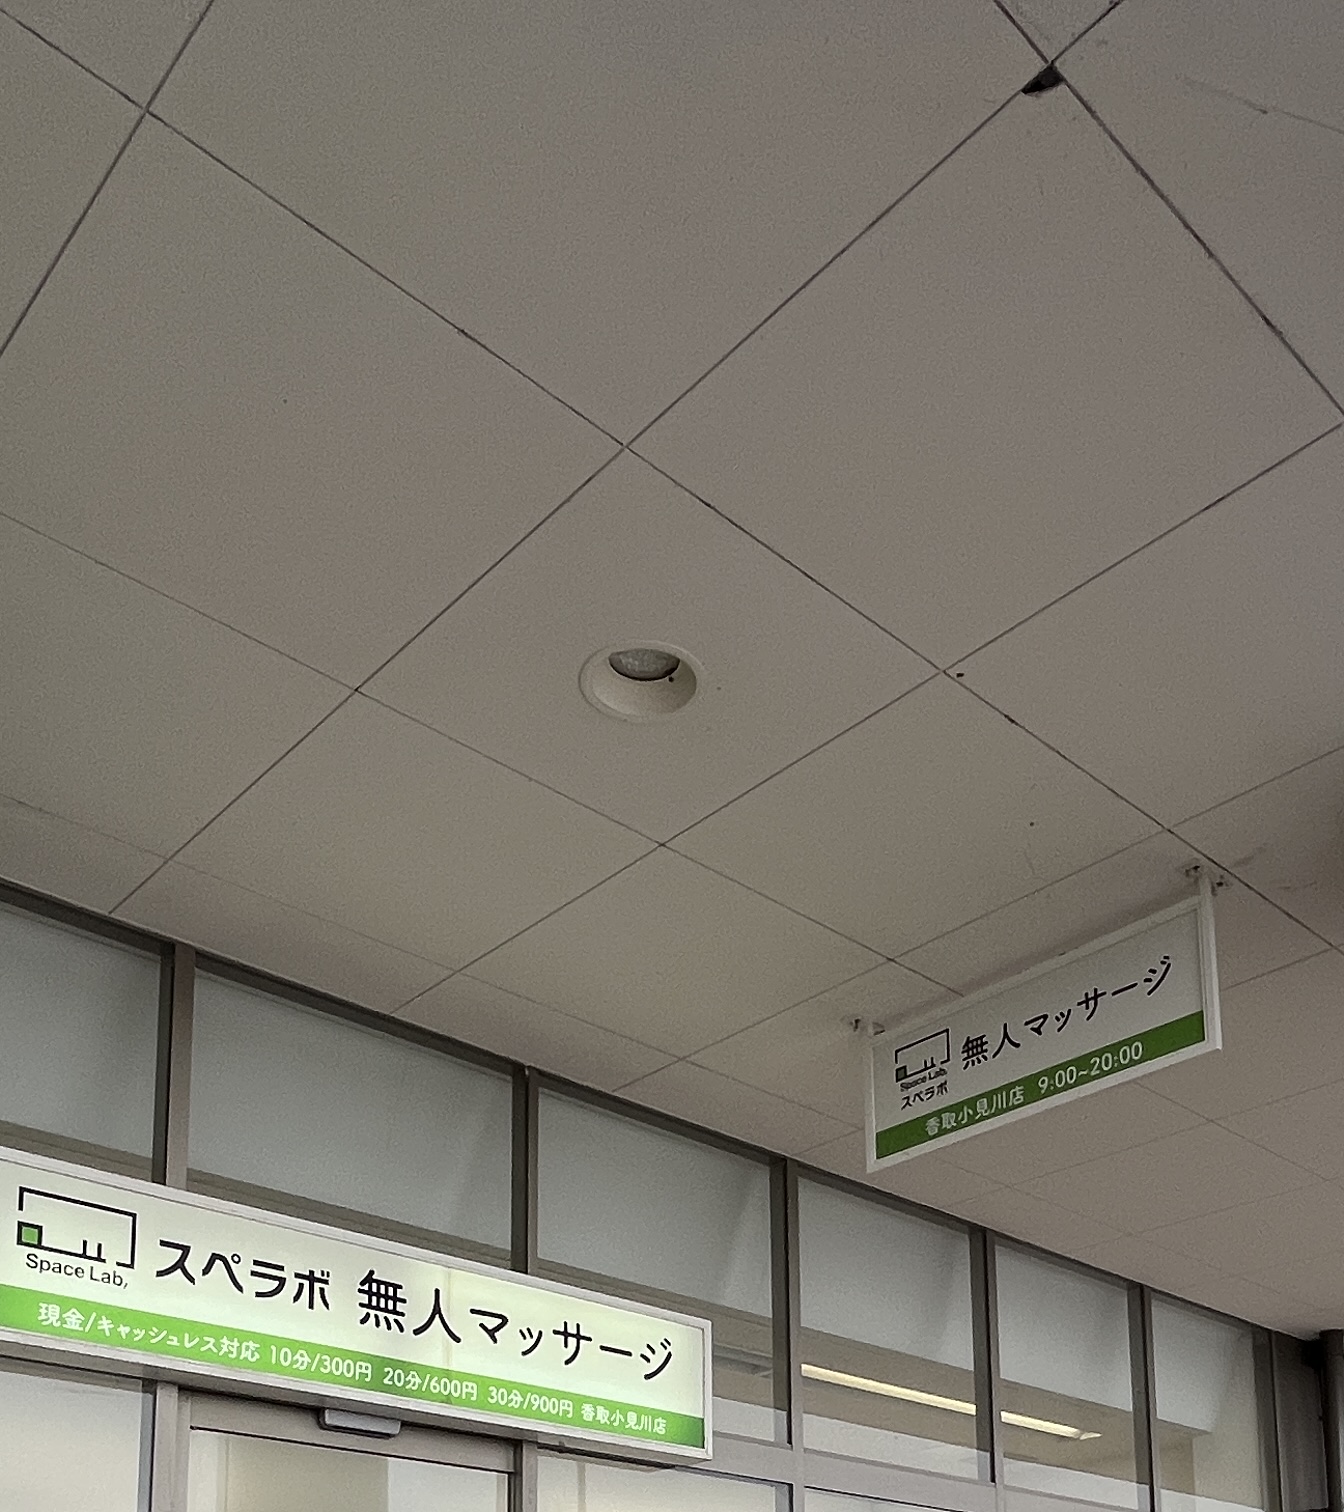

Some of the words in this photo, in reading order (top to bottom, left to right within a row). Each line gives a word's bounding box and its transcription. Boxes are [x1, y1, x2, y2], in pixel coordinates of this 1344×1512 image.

[960, 954, 1172, 1071] 無人マッサージ
[925, 1085, 1025, 1136] 香取小見川店
[25, 1253, 85, 1279] Space
[155, 1238, 332, 1311] スペラボ
[357, 1269, 674, 1381] 無人マッサージ
[37, 1302, 261, 1364] 現金/キャッシュレス対応
[270, 1344, 373, 1382] 10分/300円
[382, 1367, 479, 1402] 20分/600円
[487, 1385, 574, 1419] 30分/900円
[580, 1402, 668, 1435] 香取小見川店
